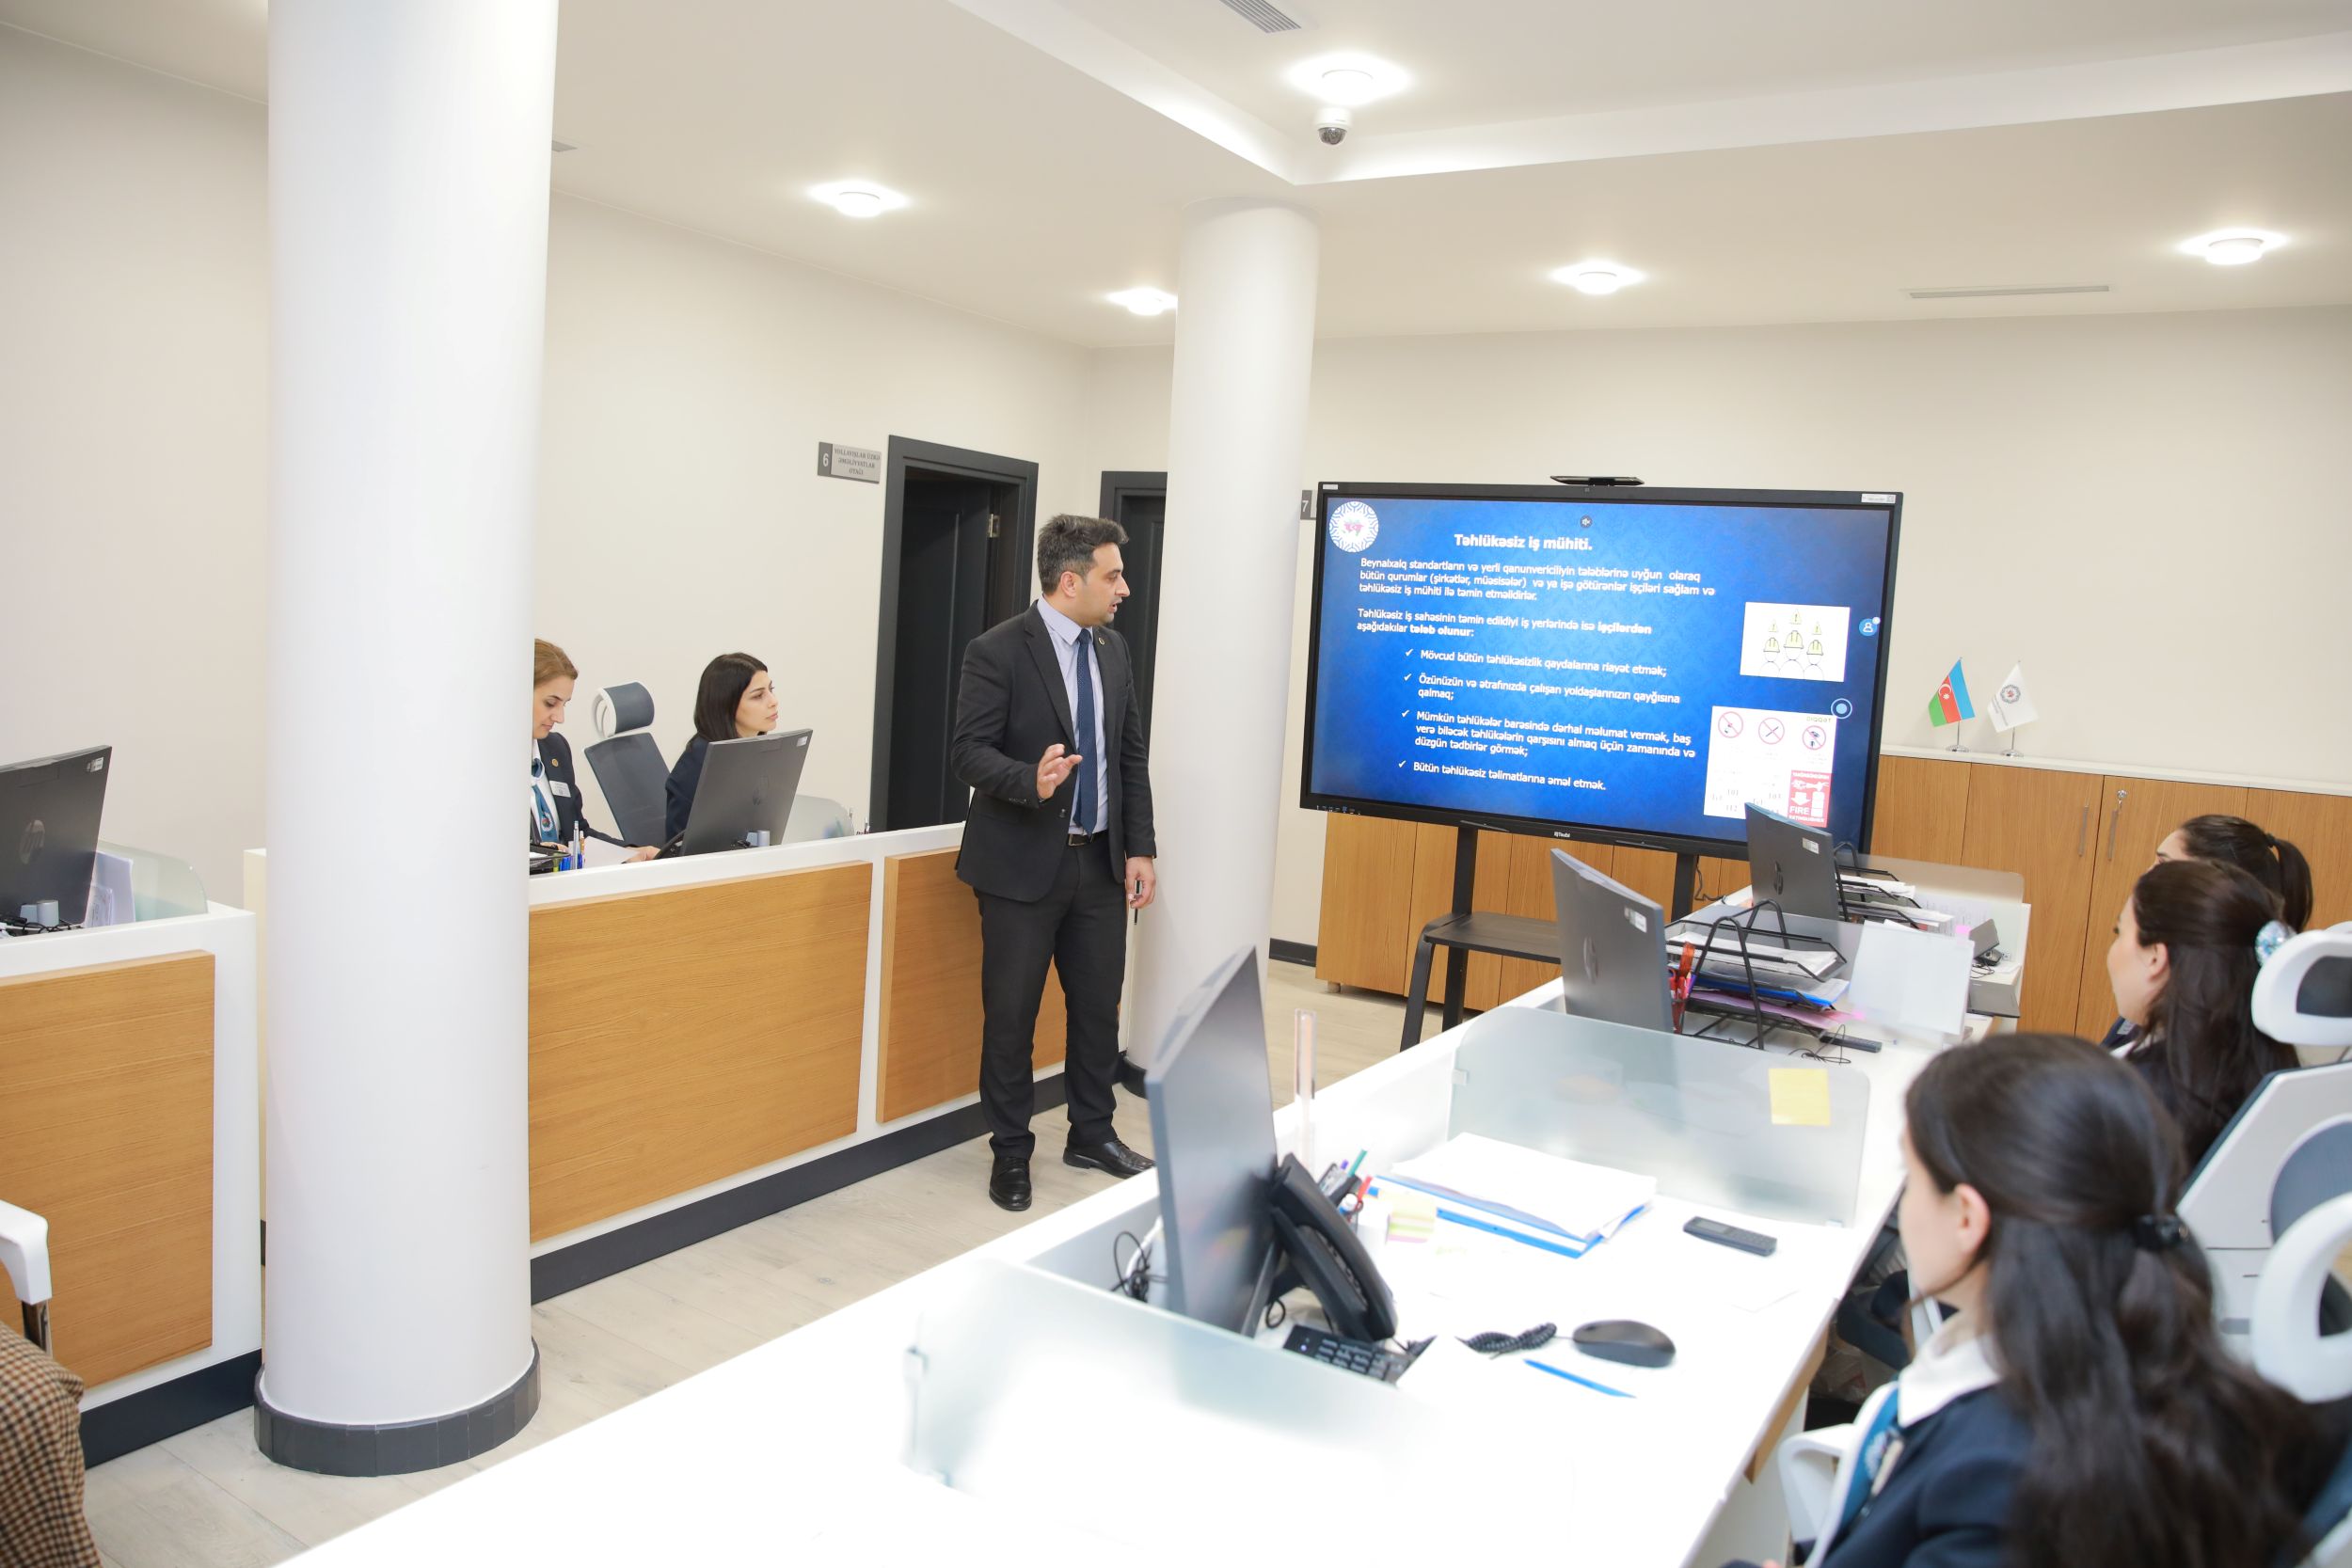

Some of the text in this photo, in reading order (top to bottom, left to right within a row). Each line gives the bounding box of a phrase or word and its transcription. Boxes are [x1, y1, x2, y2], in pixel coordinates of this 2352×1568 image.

[823, 453, 829, 467] 6
[1302, 500, 1309, 512] 7
[1454, 533, 1593, 551] Təhlükəsiz iş mühiti.
[1360, 570, 1385, 581] bütün
[1387, 573, 1428, 584] qurumlar
[1430, 573, 1470, 586] (şirkətlər,
[1547, 581, 1557, 590] ya
[1560, 579, 1573, 591] işə
[1576, 581, 1627, 592] götürənlər
[1629, 582, 1661, 595] işçiləri
[1663, 583, 1700, 596] sağlam
[1481, 563, 1501, 575] yerli
[1502, 564, 1576, 578] qanunvericiliyin
[1578, 567, 1629, 578] tələblərinə
[1631, 568, 1662, 581] uyğun
[1669, 570, 1701, 583] olaraq
[1359, 583, 1538, 601] təhlükəsiz iş mühiti ilə təmin etməlidirlər.
[1357, 621, 1474, 637] aşağıdakılar tələb olunur:
[1358, 608, 1652, 634] Təhlükəsiz iş sahəsinin təmin edildiyi iş yerlərində isə işçilərdən
[1421, 649, 1455, 661] Mövcud
[1457, 652, 1483, 663] bütün
[1486, 654, 1542, 667] təhlükəsizlik
[1602, 662, 1629, 674] riayət
[1632, 665, 1667, 678] etmək;
[1418, 688, 1454, 701] qalmaq;
[1419, 673, 1463, 687] Özünüzün
[1479, 679, 1526, 691] ətrafınızda
[1529, 683, 1561, 696] çalışan
[1633, 691, 1680, 704] qayğısına
[1417, 711, 1691, 746] Mümkün təhlükələr barəsində dərhal məlumat vermək, baş
[1415, 736, 1528, 757] düzgün tədbirlər görmək;
[1416, 725, 1696, 758] verə biləcək təhlükələrin qarşısını almaq üçün zamanında və
[1414, 761, 1439, 773] Bütün
[1442, 765, 1486, 778] təhlükəsiz
[1548, 776, 1571, 787] əməl
[1573, 779, 1606, 791] etmək.
[1789, 807, 1810, 816] FIRE
